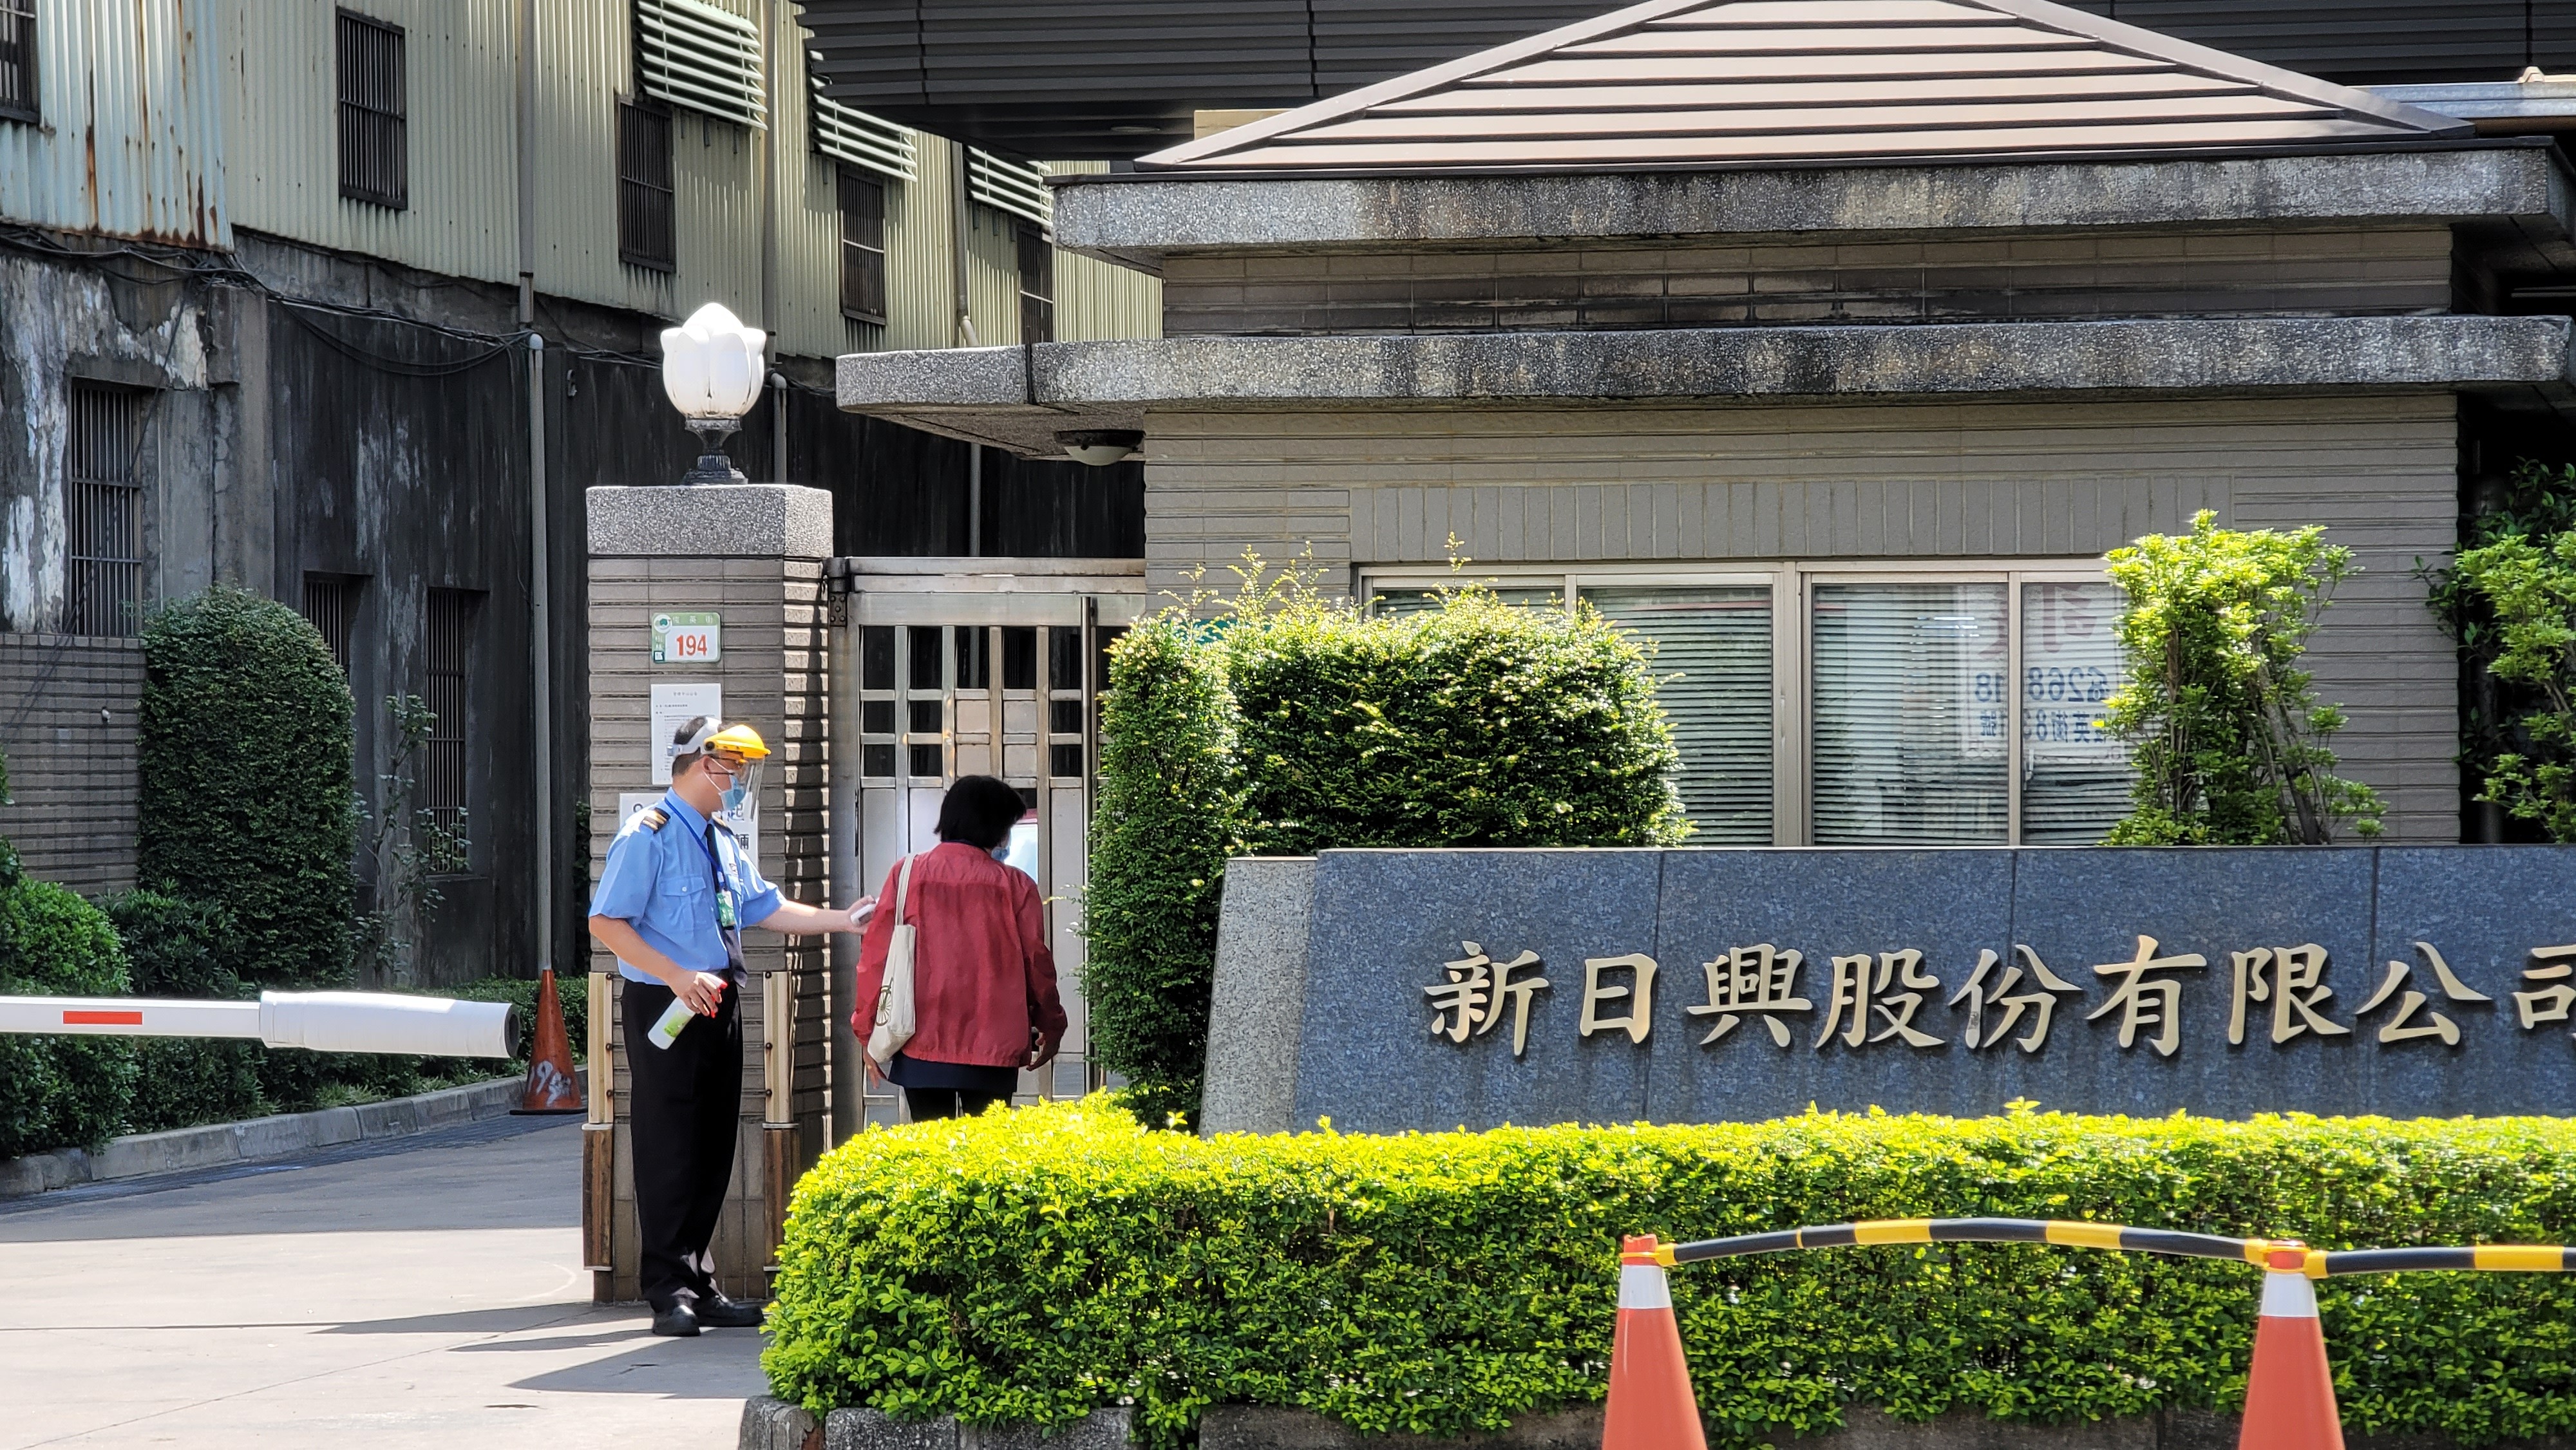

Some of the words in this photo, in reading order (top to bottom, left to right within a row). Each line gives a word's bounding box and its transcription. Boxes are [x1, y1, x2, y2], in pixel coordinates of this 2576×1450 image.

[677, 634, 707, 656] 194
[1423, 935, 2576, 1057] 新日興股份有限公司
